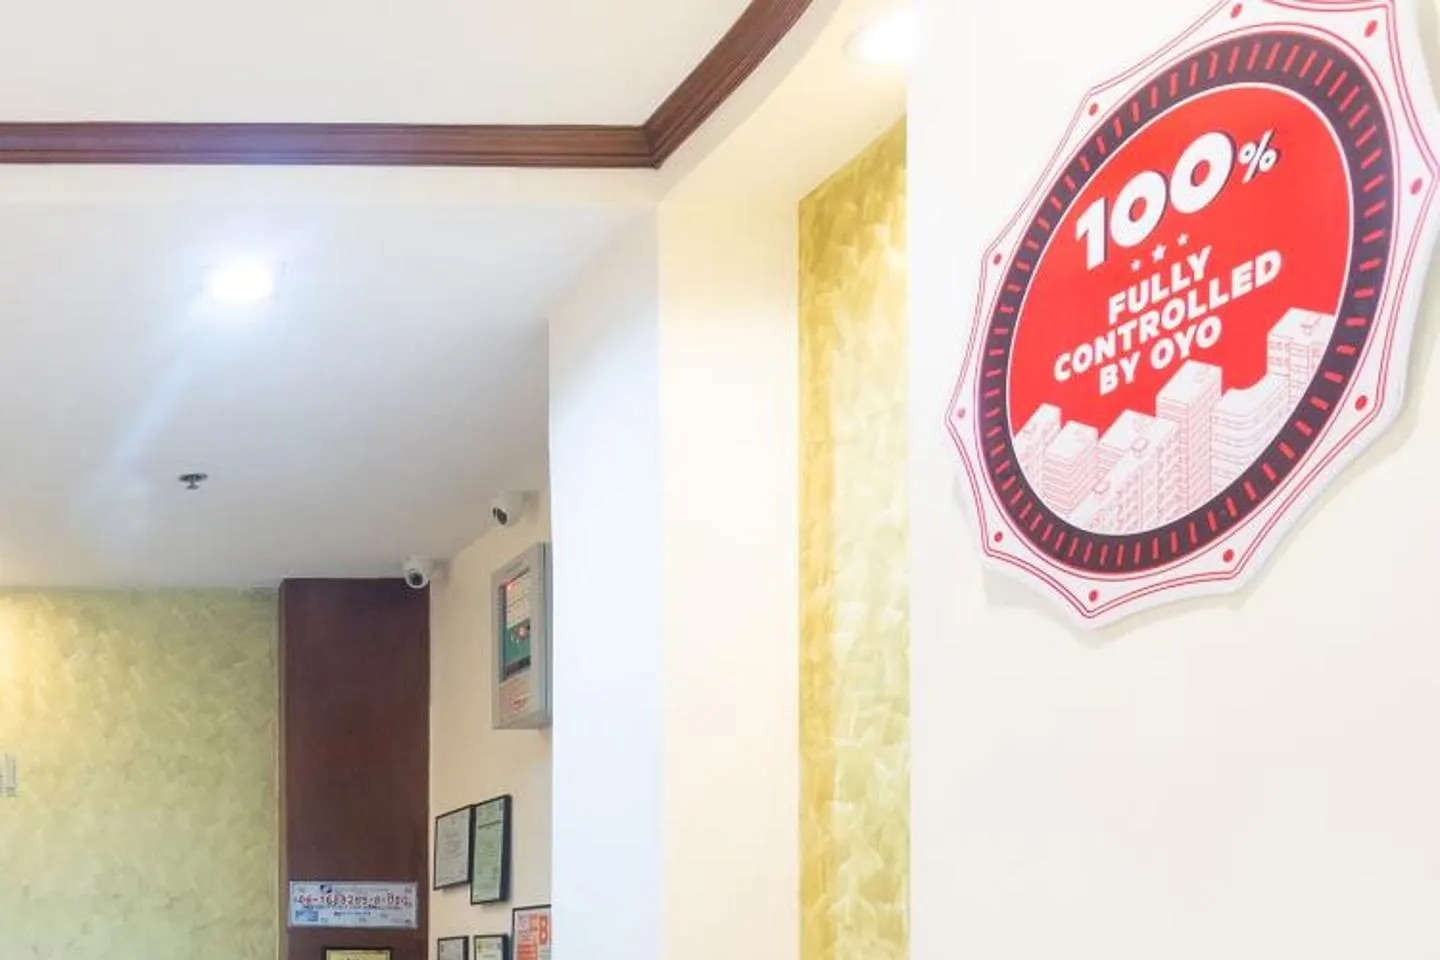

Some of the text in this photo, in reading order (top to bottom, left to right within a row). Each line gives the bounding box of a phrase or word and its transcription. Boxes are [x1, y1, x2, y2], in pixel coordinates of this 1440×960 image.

[1075, 129, 1279, 271] 100%
[1053, 249, 1283, 382] CONTROLLED
[1108, 245, 1213, 325] FULLY
[1098, 315, 1223, 396] BY OYO
